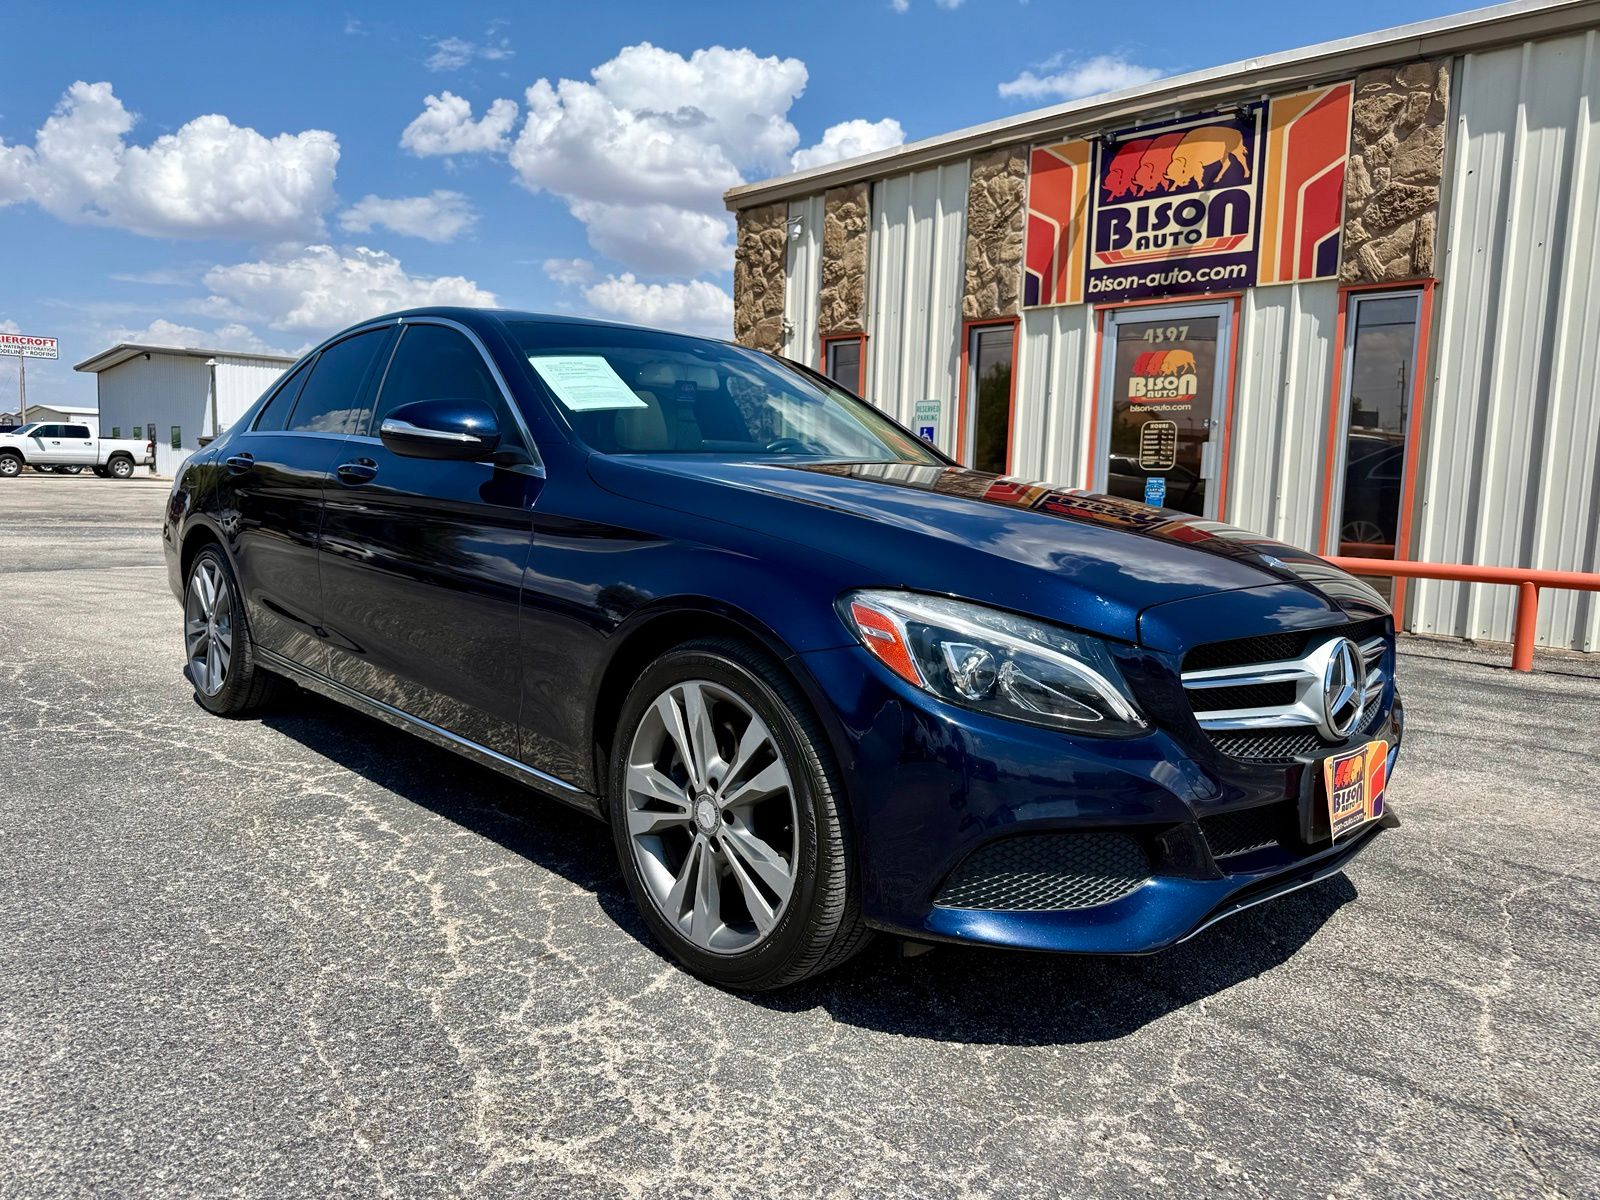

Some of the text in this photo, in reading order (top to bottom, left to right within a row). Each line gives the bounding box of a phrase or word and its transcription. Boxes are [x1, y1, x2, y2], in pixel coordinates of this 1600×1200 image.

[1095, 189, 1251, 251] BISON
[1136, 228, 1202, 250] AUTO
[1088, 264, 1247, 293] bison-auto.com
[1143, 326, 1189, 343] 4397
[1128, 374, 1198, 397] BISON
[1147, 390, 1178, 398] AUTO
[1130, 404, 1192, 412] bison-auto.com
[1333, 782, 1363, 813] BISON
[1341, 801, 1356, 812] AUTO
